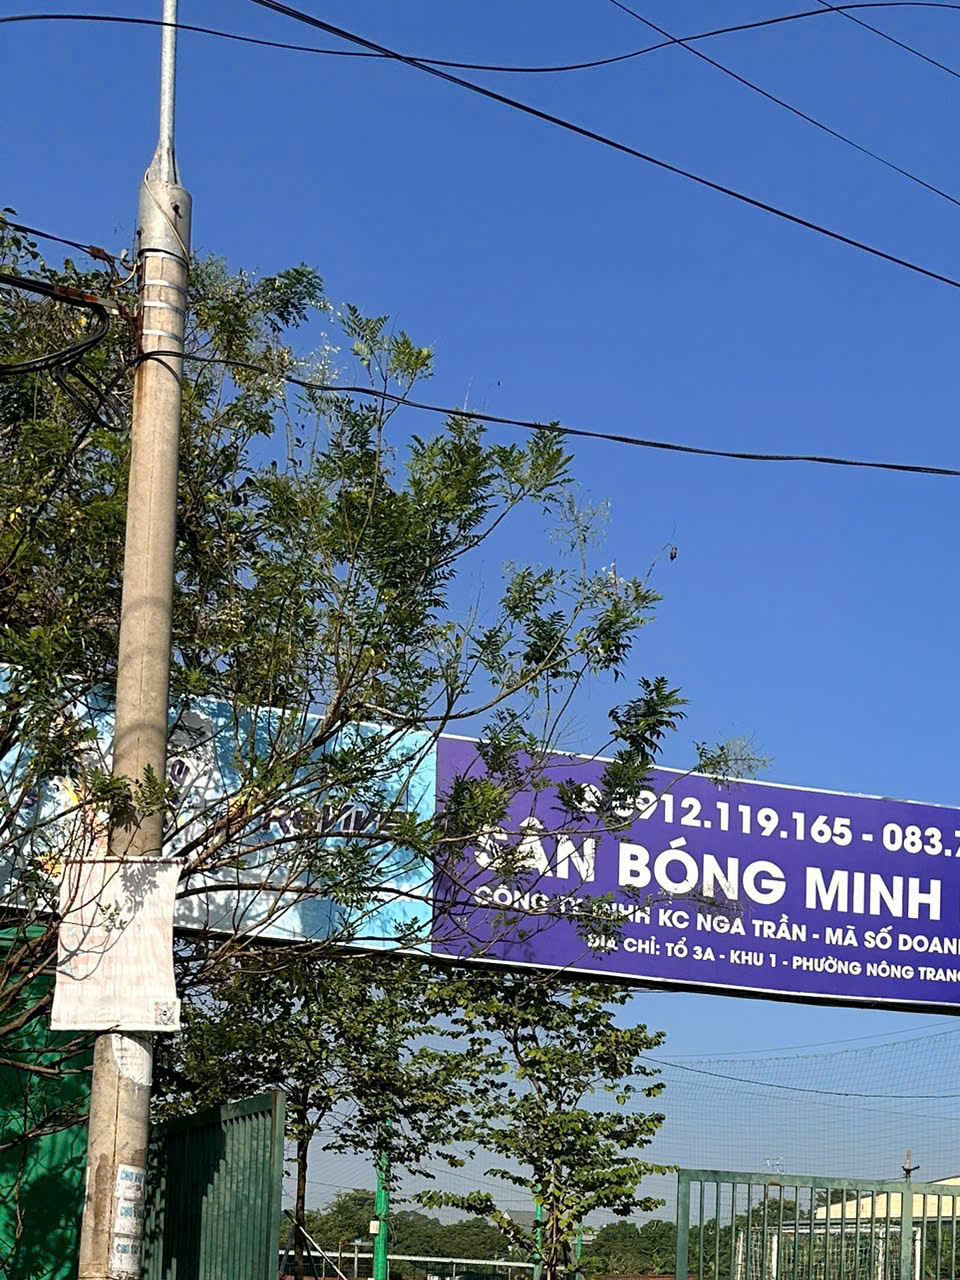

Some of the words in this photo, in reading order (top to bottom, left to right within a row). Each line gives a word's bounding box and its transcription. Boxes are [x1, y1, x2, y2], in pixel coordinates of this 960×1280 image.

[474, 816, 596, 882] SÂN
[618, 836, 787, 905] BÓNG
[805, 866, 942, 921] MINH
[474, 884, 550, 912] CÔNG
[658, 908, 691, 930] KC
[696, 912, 746, 936] NGA
[752, 913, 806, 942] TRẦN
[864, 925, 894, 949] SỐ
[623, 935, 661, 956] CHỈ:
[665, 937, 688, 958] TỔ
[692, 945, 716, 961] 3A
[730, 949, 764, 967] KHU
[769, 953, 777, 967] 1
[792, 955, 862, 976] PHƯỜNG
[866, 960, 915, 980] NÔNG
